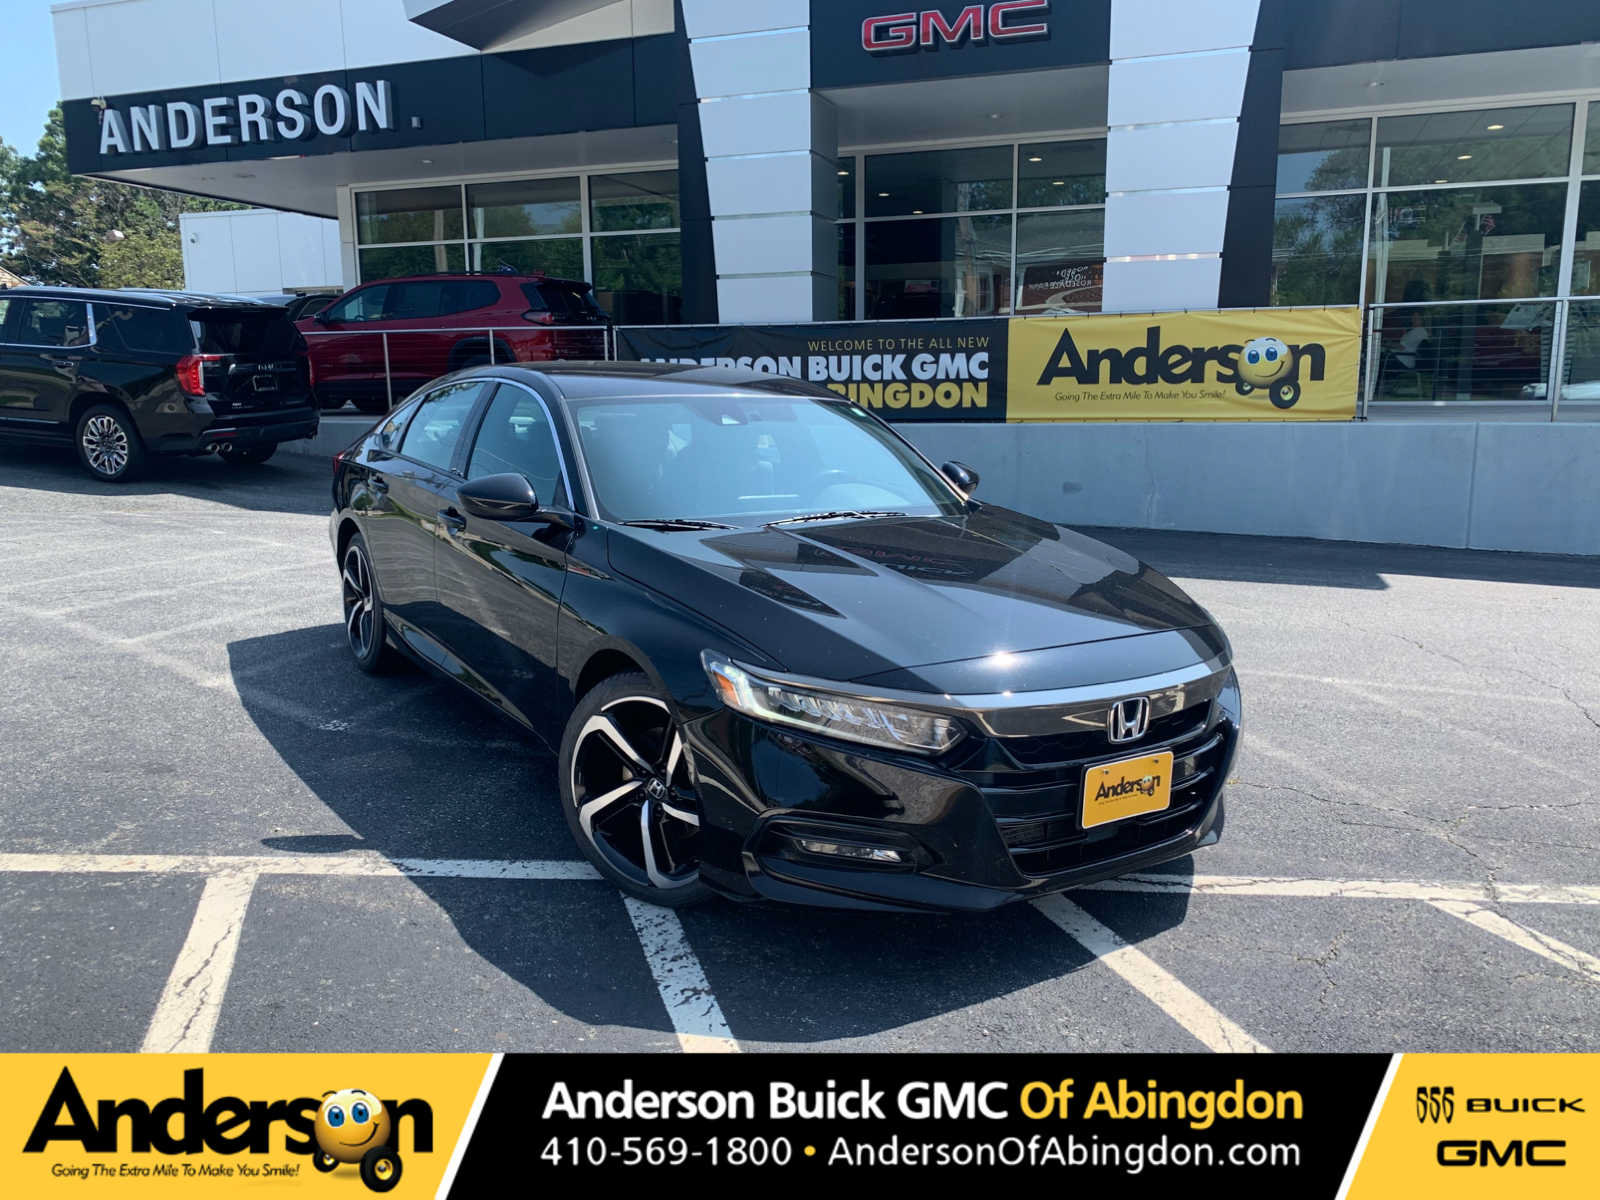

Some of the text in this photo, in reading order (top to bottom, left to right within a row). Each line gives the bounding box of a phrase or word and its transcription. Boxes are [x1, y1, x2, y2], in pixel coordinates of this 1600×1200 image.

[863, 0, 1049, 51] GMC
[99, 79, 390, 155] ANDERSON
[808, 336, 989, 351] WELCOME TO THE ALL NEW
[807, 354, 907, 382] BUICK
[911, 352, 989, 381] GMC
[1055, 390, 1227, 402] Going The Extra Mile To Make You Smile!
